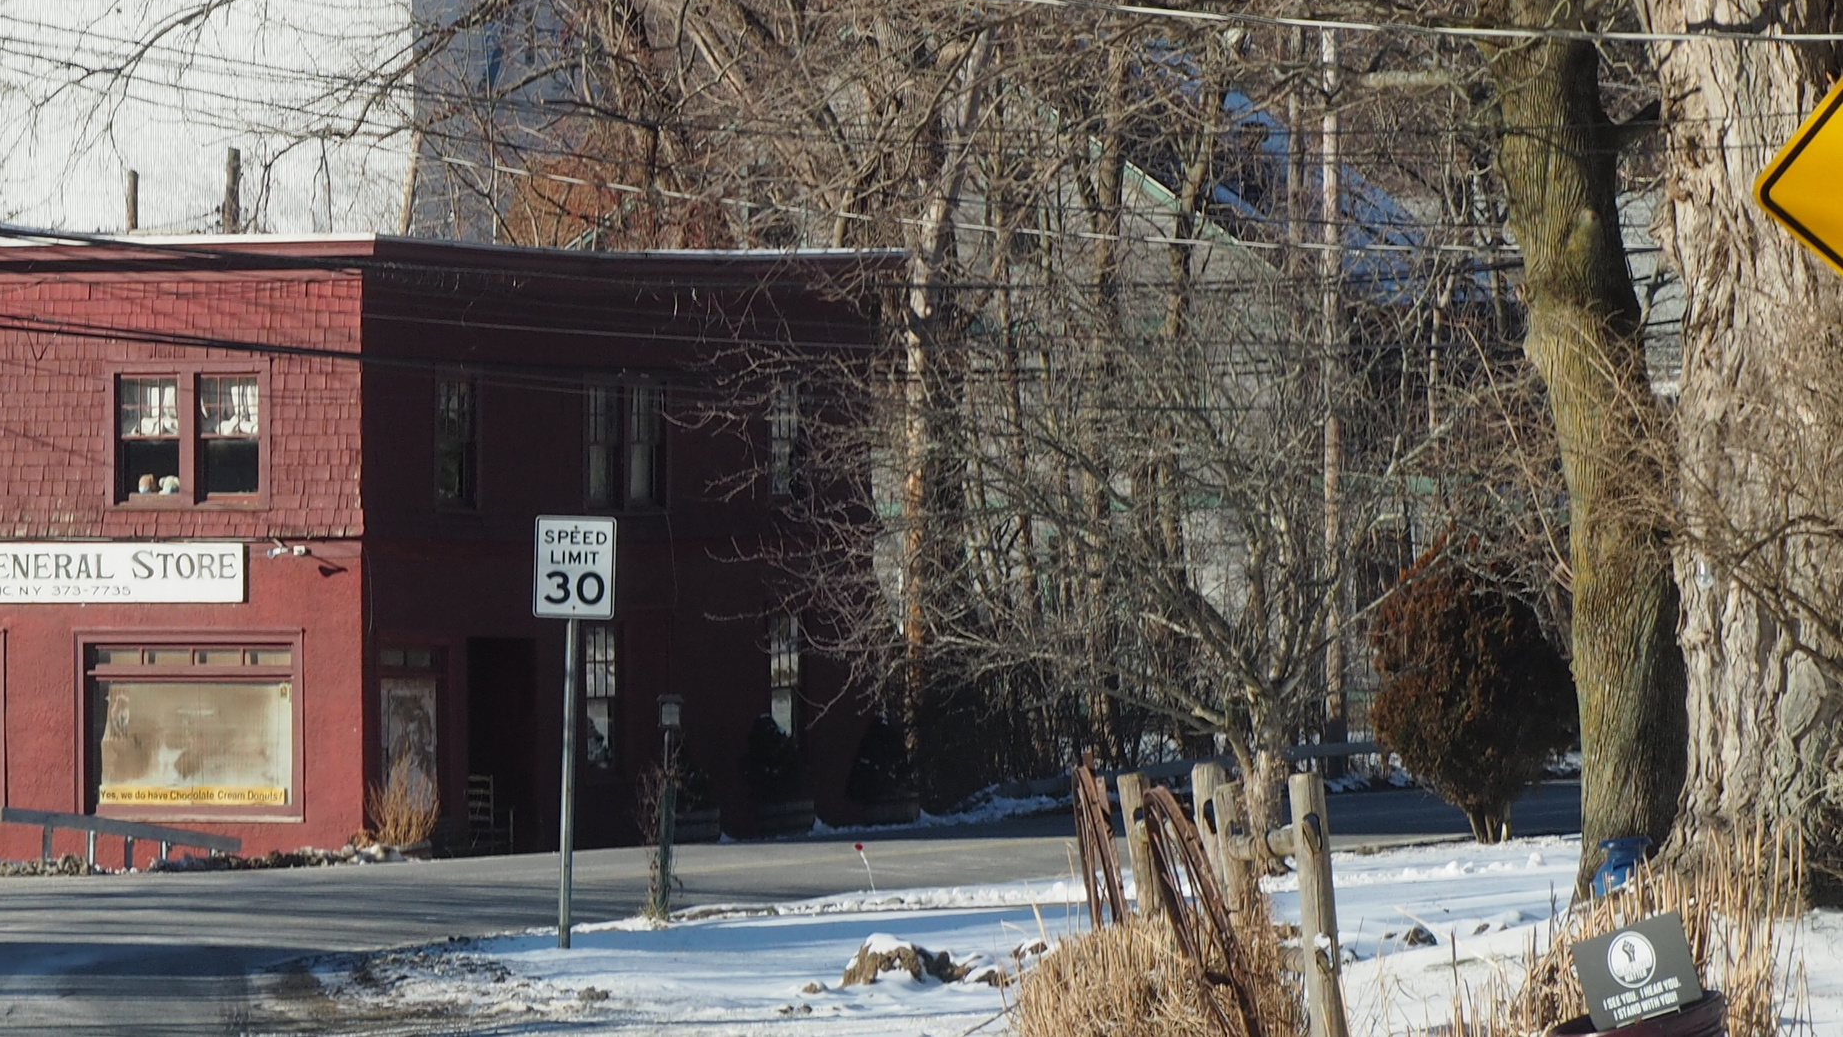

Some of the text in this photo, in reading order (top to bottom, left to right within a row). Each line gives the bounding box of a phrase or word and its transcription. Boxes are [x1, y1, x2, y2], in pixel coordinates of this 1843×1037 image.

[543, 529, 608, 546] SPEED
[131, 549, 238, 580] STORE
[550, 549, 600, 566] LIMIT
[51, 585, 132, 597] 373-7735
[543, 570, 605, 606] 30
[100, 789, 119, 801] Yes,
[121, 791, 133, 800] we
[134, 790, 146, 800] do
[147, 789, 168, 800] have
[169, 789, 215, 801] Chocolate
[217, 790, 246, 801] Cream
[1603, 999, 1608, 1011] I
[1607, 994, 1622, 1010] SEE
[1639, 987, 1645, 999] I
[1643, 981, 1664, 998] HEAR
[1662, 976, 1682, 991] YOU.
[1613, 1009, 1618, 1021] I
[1617, 1002, 1642, 1020] STAND
[1641, 996, 1661, 1012] WITH
